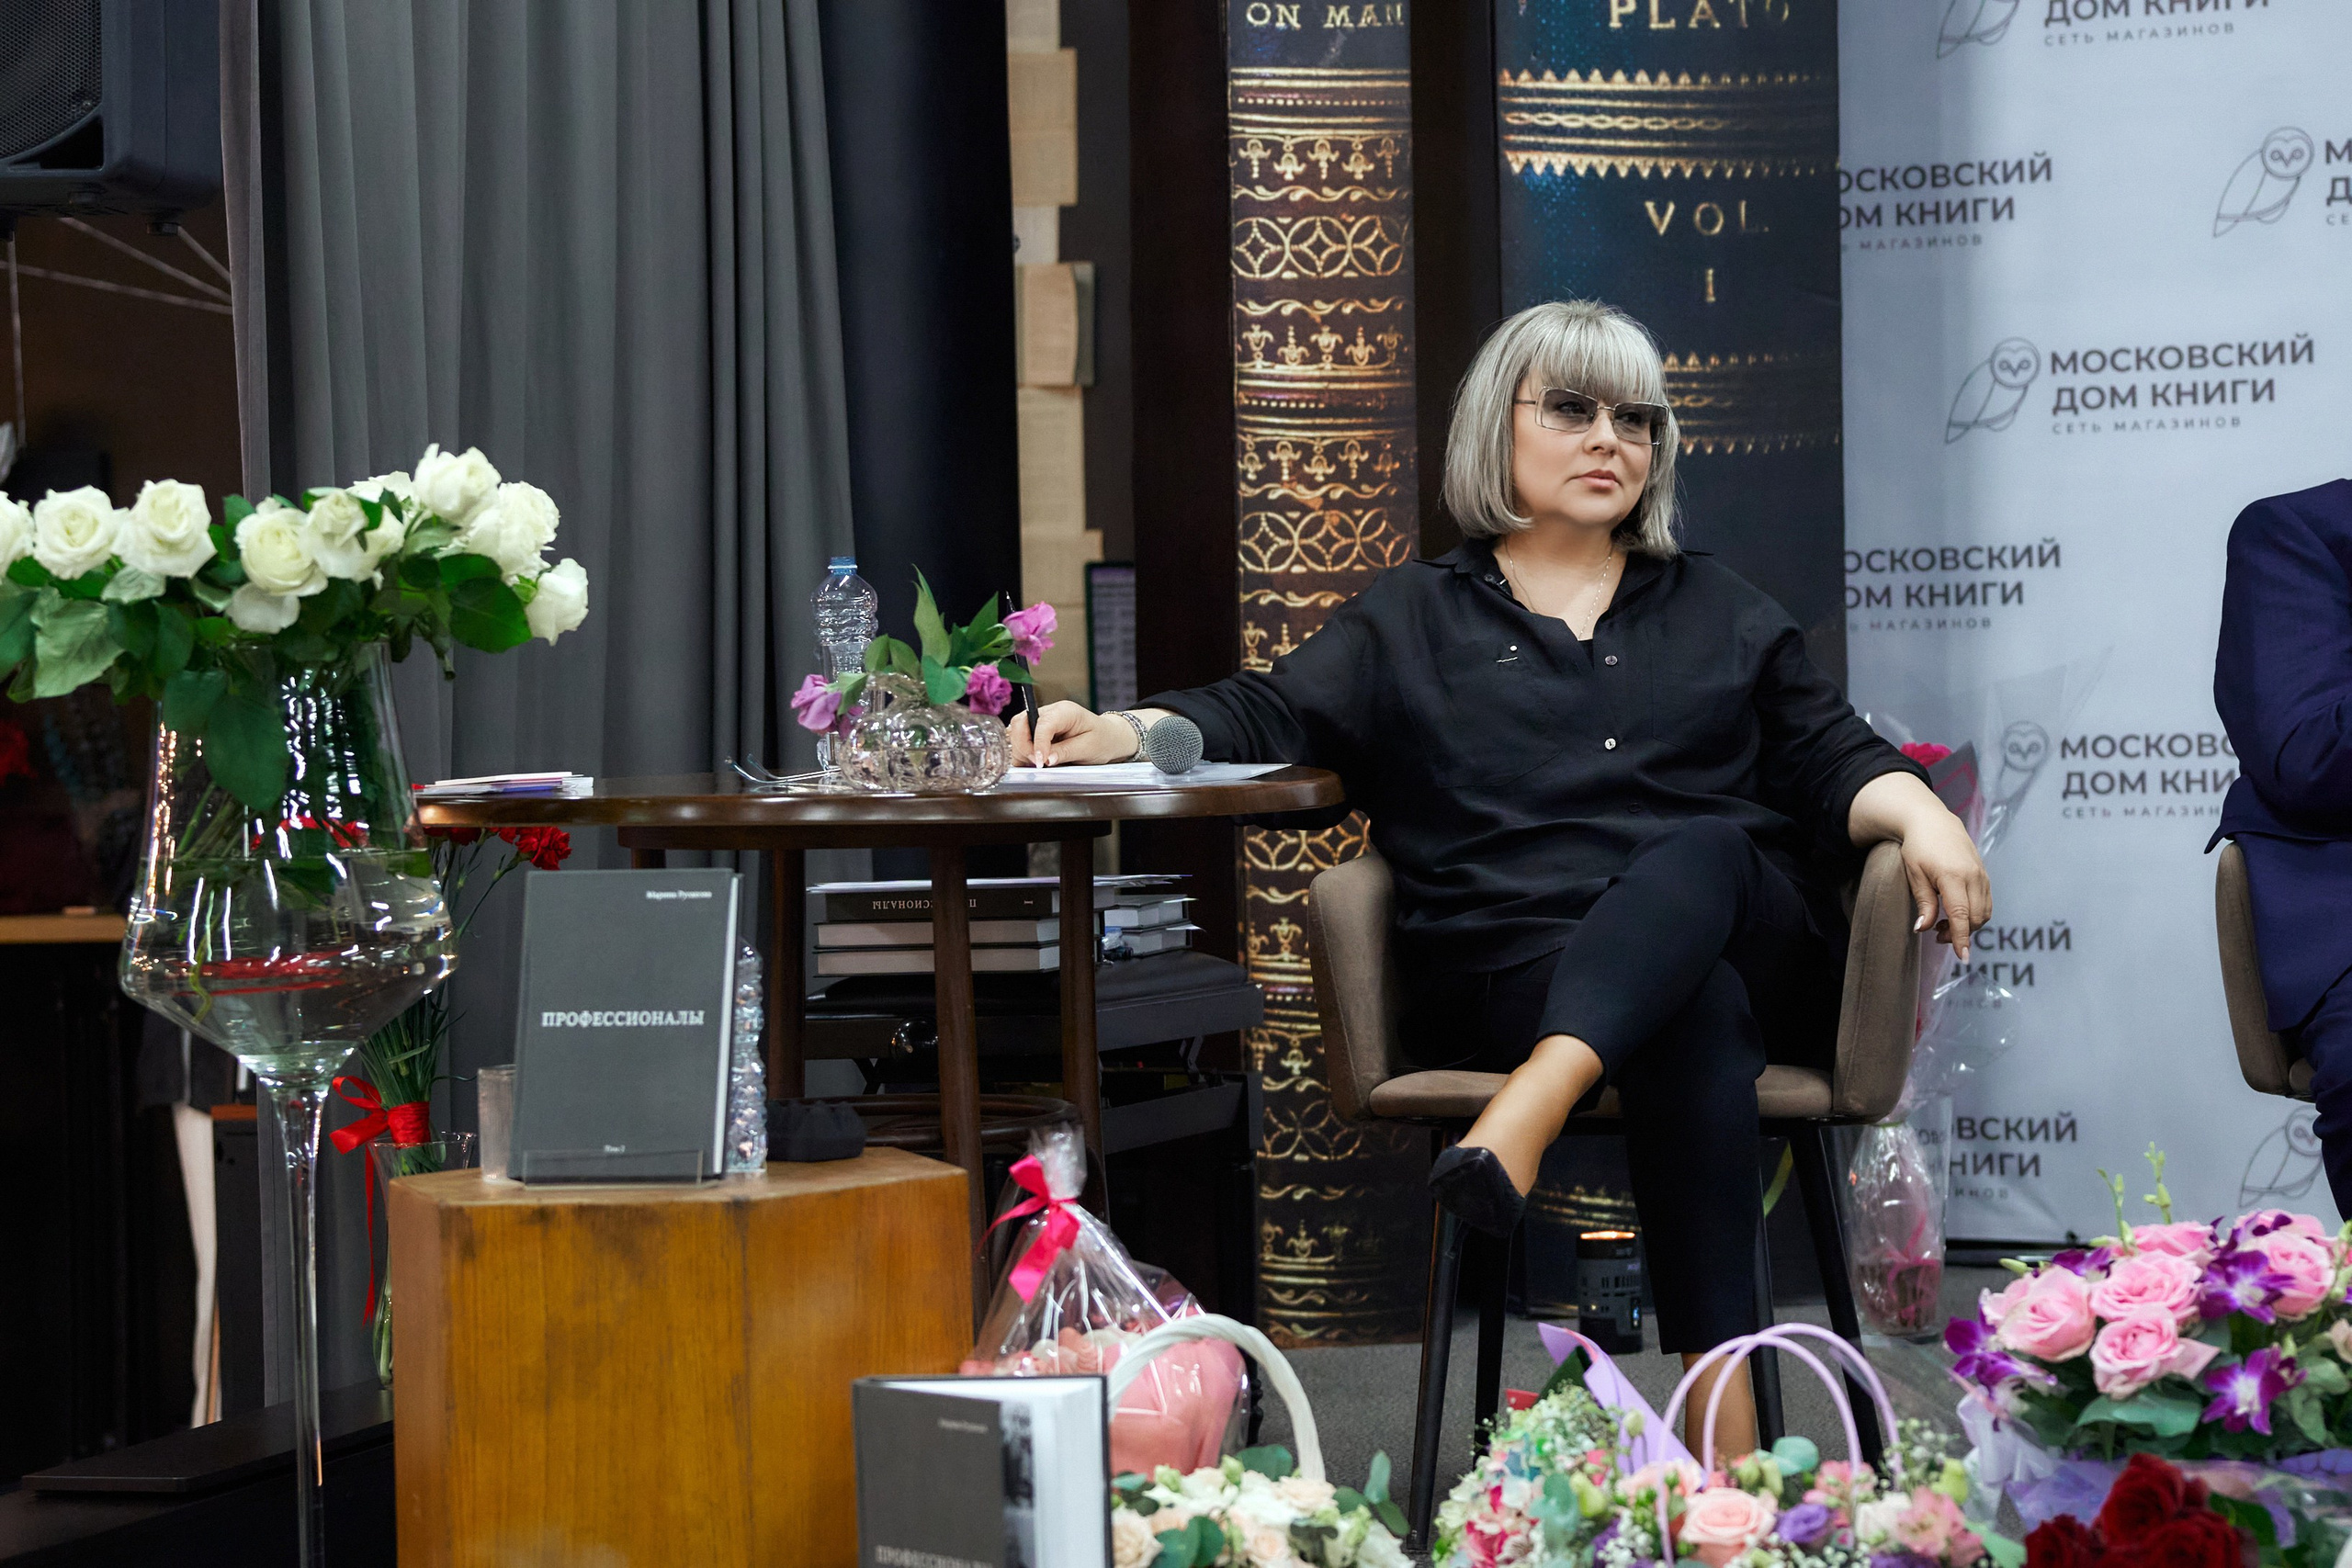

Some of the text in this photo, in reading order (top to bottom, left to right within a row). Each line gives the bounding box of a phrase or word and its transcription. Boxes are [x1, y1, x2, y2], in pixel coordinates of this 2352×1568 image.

[1246, 2, 1405, 30] ON MAN
[2044, 0, 2131, 28] ДОМ
[2044, 22, 2234, 46] СЕТЬ МАГАЗИНОВ
[1839, 151, 2052, 194] ОСКОВСКИЙ
[1895, 196, 2014, 227] КНИГИ
[2051, 333, 2314, 375] МОСКОВСКИЙ
[2052, 378, 2276, 416] ДОМ КНИГИ
[2052, 416, 2242, 435] СЕТЬ МАГАЗИНОВ
[1845, 536, 2061, 573] ОСКОВСКИЙ
[1845, 581, 2024, 610] ОМ КНИГИ
[1870, 617, 1991, 631] МАГАЗИНОВ
[2061, 732, 2238, 760] МОСКОВС
[2062, 769, 2236, 800] ДОМ КНИ
[2123, 805, 2221, 818] МАГАЗИН
[873, 898, 977, 910] ПСИОНАЛЫ
[541, 1010, 706, 1028] ПРОФЕССИОНАЛЫ
[1956, 1111, 2077, 1143] ВСКИЙ
[1950, 1152, 2041, 1177] НИГИ
